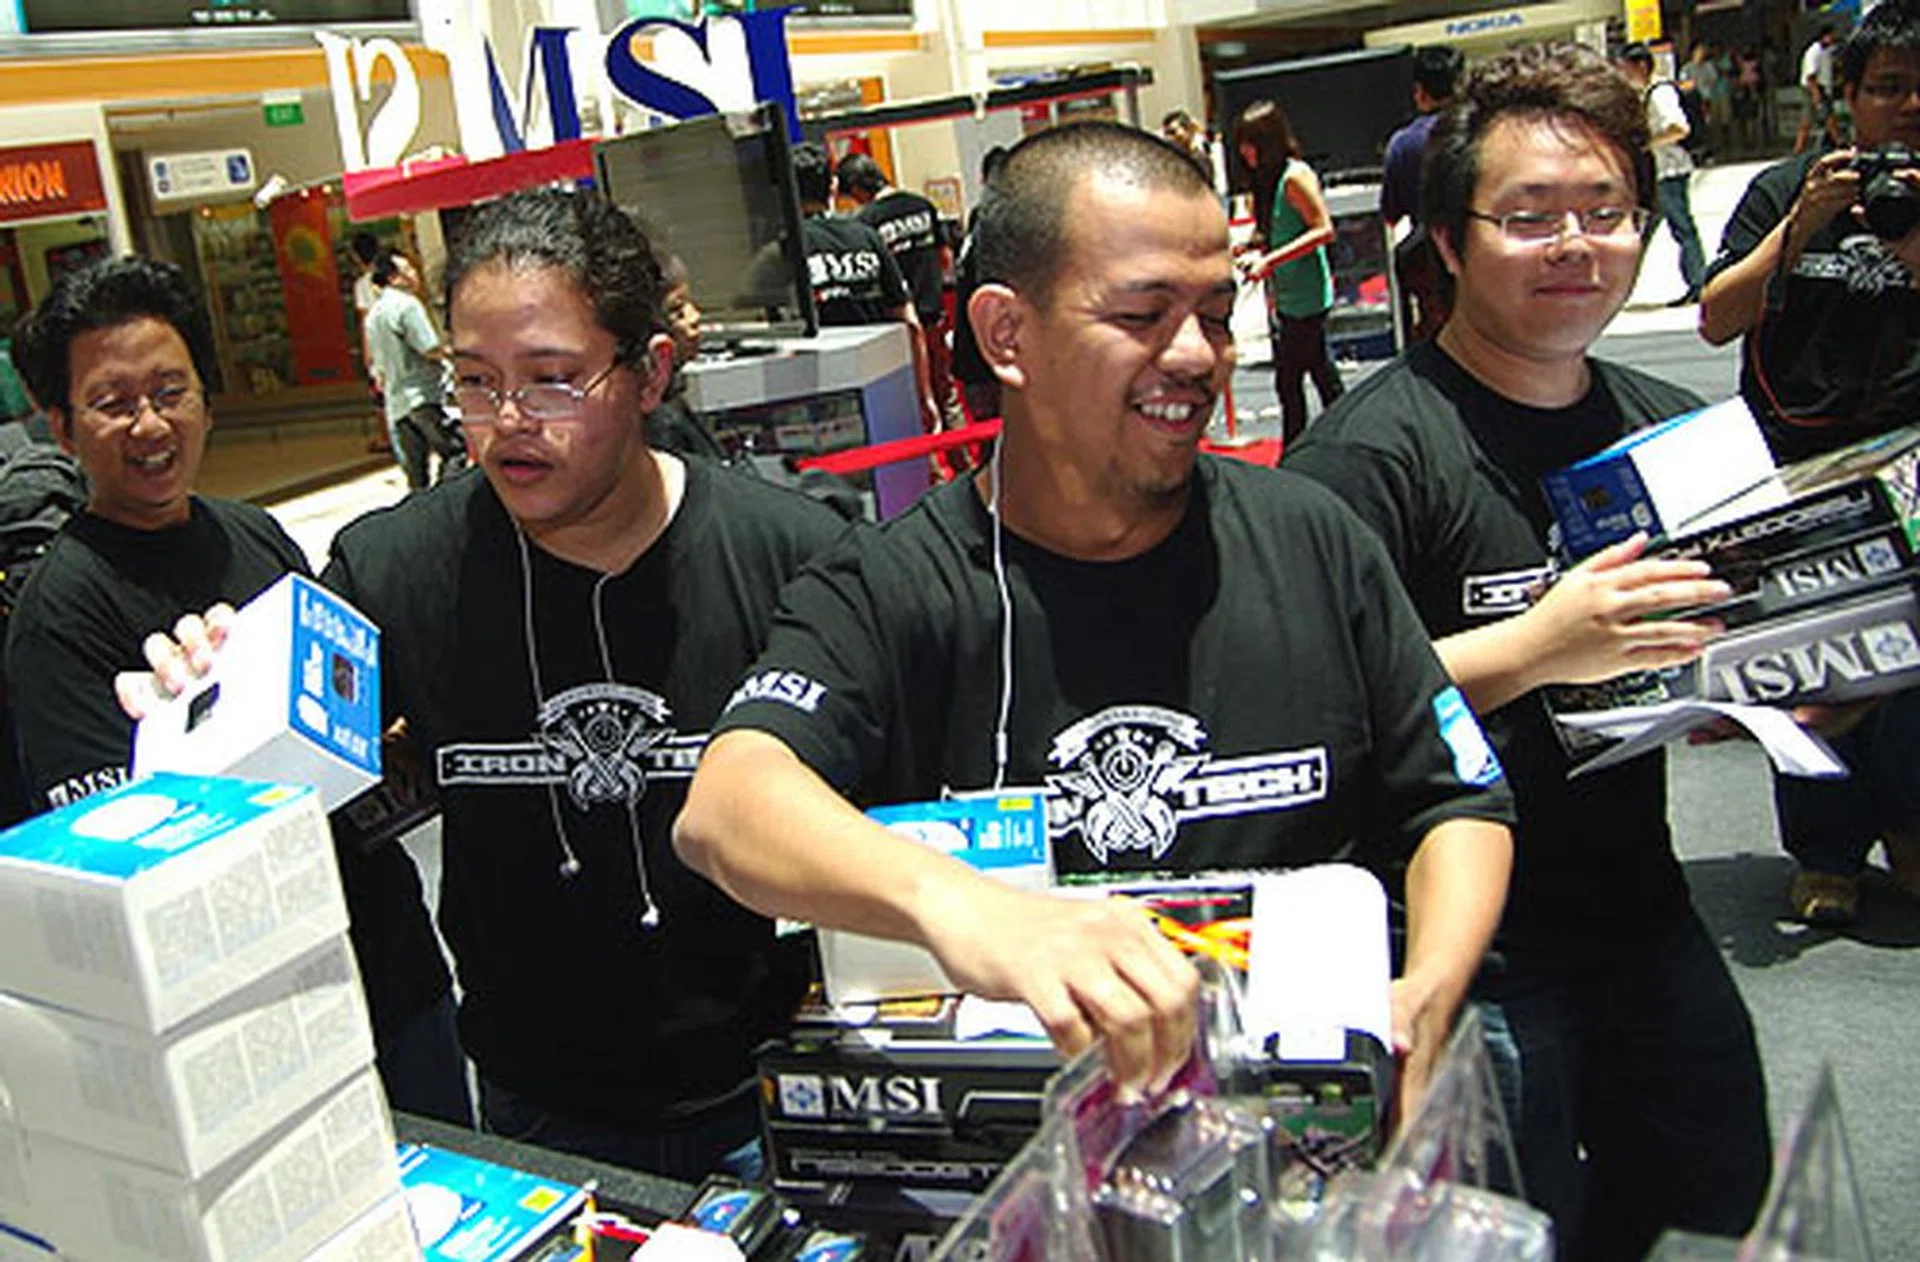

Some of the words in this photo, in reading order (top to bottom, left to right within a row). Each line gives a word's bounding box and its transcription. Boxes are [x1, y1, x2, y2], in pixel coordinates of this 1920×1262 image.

[1446, 13, 1523, 34] NOKIA
[1775, 552, 1862, 597] MSI
[1720, 632, 1875, 704] MSI
[746, 670, 829, 713] MSI
[453, 753, 568, 773] IRON
[649, 746, 703, 769] TE
[66, 765, 130, 799] MSI
[1177, 761, 1315, 808] TECH
[829, 1074, 942, 1115] MSI
